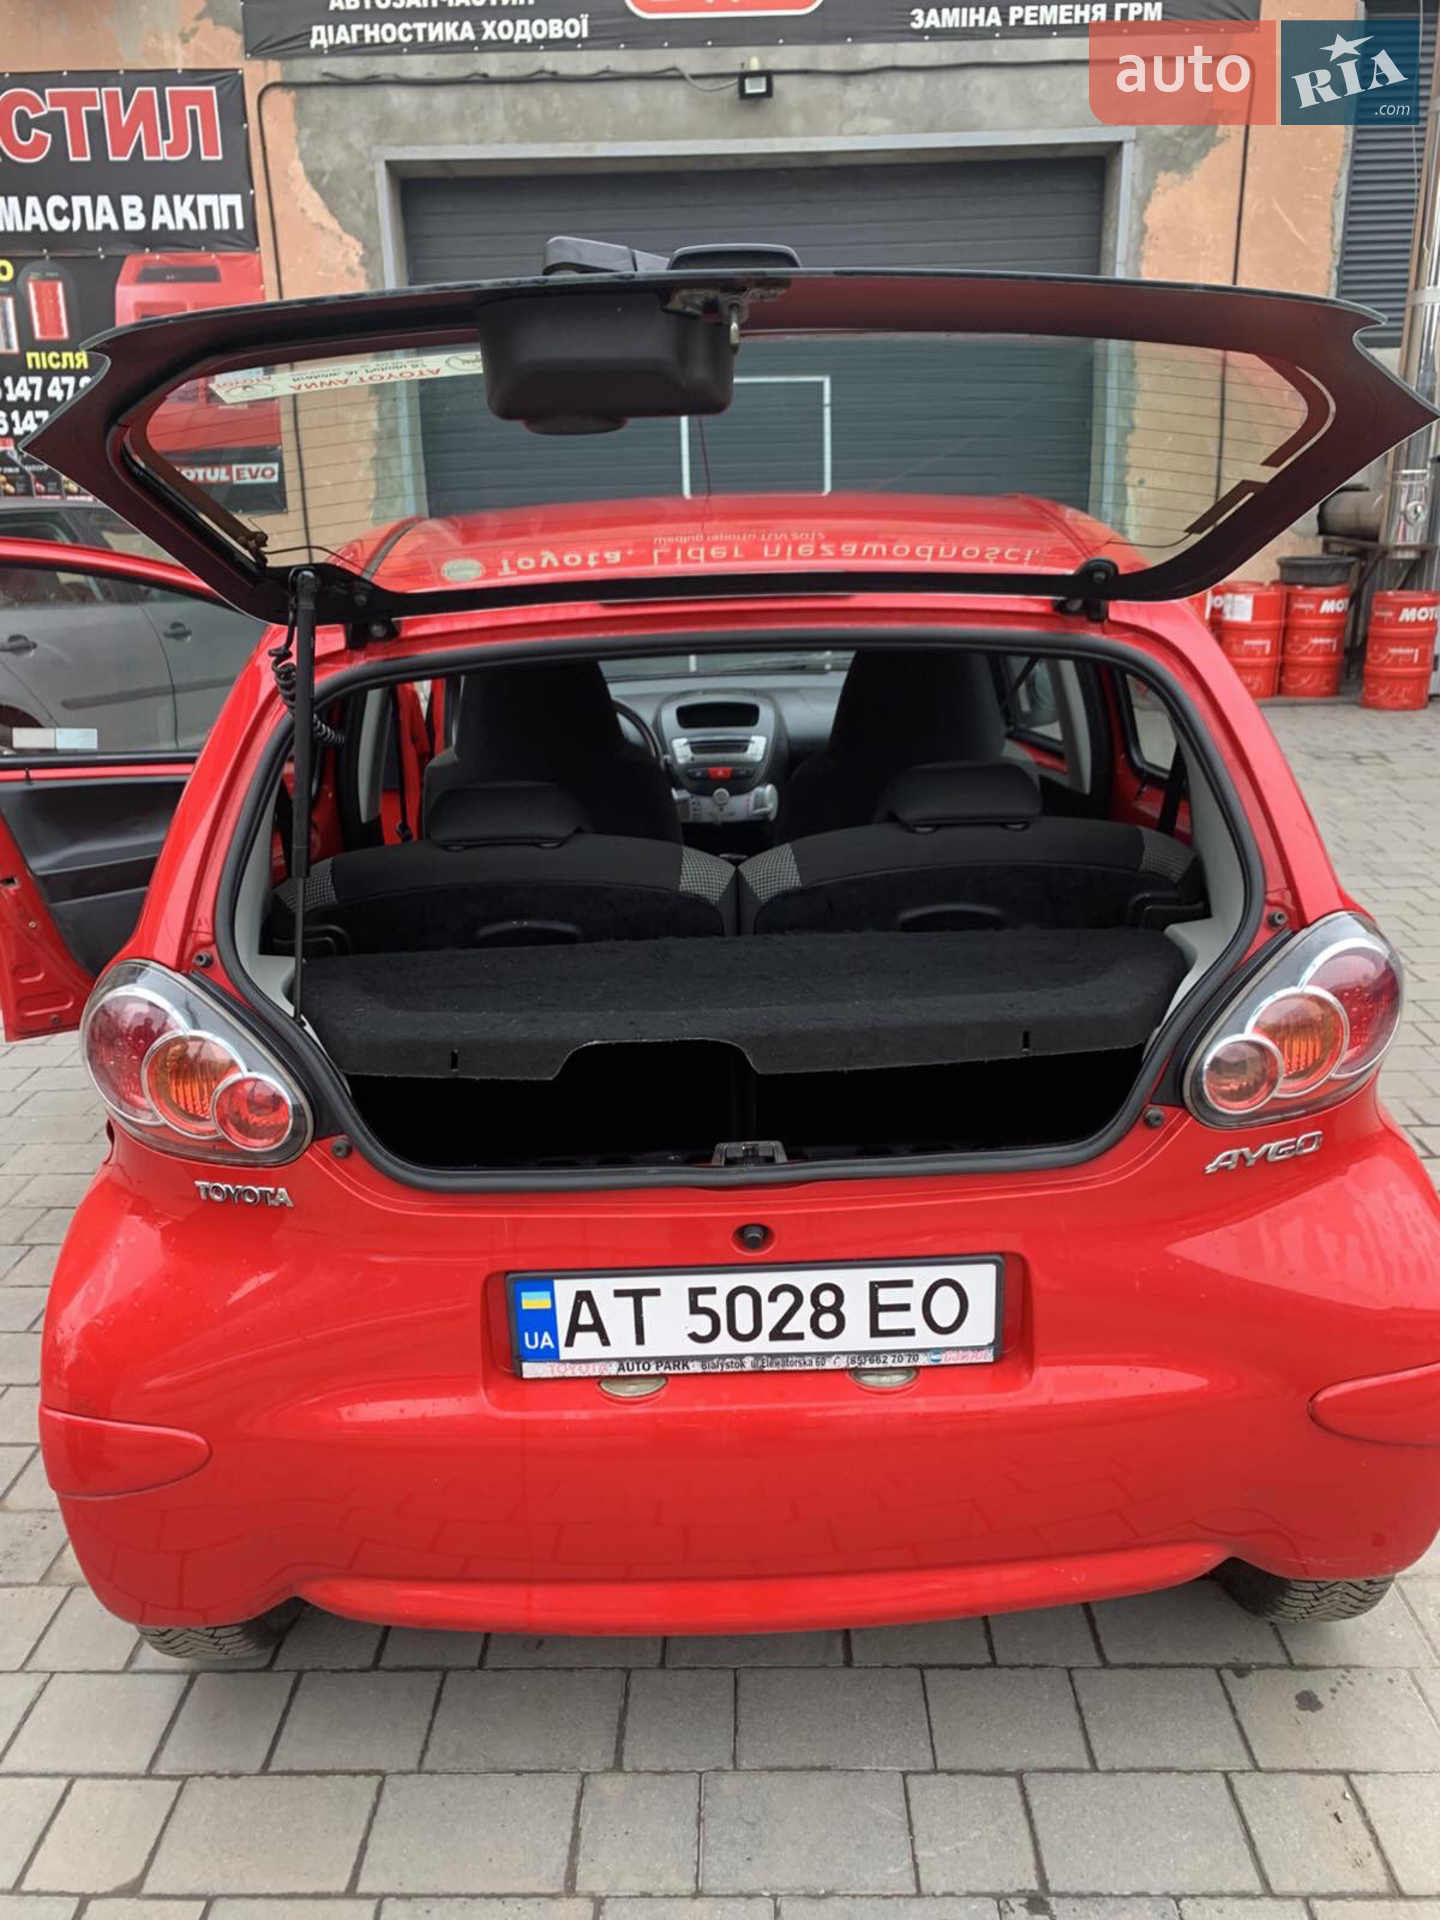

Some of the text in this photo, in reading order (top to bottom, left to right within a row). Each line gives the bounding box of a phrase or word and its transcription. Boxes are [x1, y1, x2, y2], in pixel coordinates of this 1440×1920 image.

[910, 2, 1163, 29] ЗАМІНА РЕМЕНЯ ГРМ
[310, 13, 589, 49] ДІАГНОСТИКА ХОДОВОЇ
[0, 193, 244, 232] МАСЛА В АКПП
[25, 351, 90, 370] ПІСЛЯ
[175, 465, 276, 483] OTUL EVO
[1204, 1130, 1323, 1174] AYGO
[194, 1180, 295, 1207] TOYOTA
[563, 1277, 970, 1348] AT 5028 EO
[524, 1332, 555, 1350] UA
[617, 1361, 650, 1373] AUTO
[655, 1360, 691, 1372] PARK
